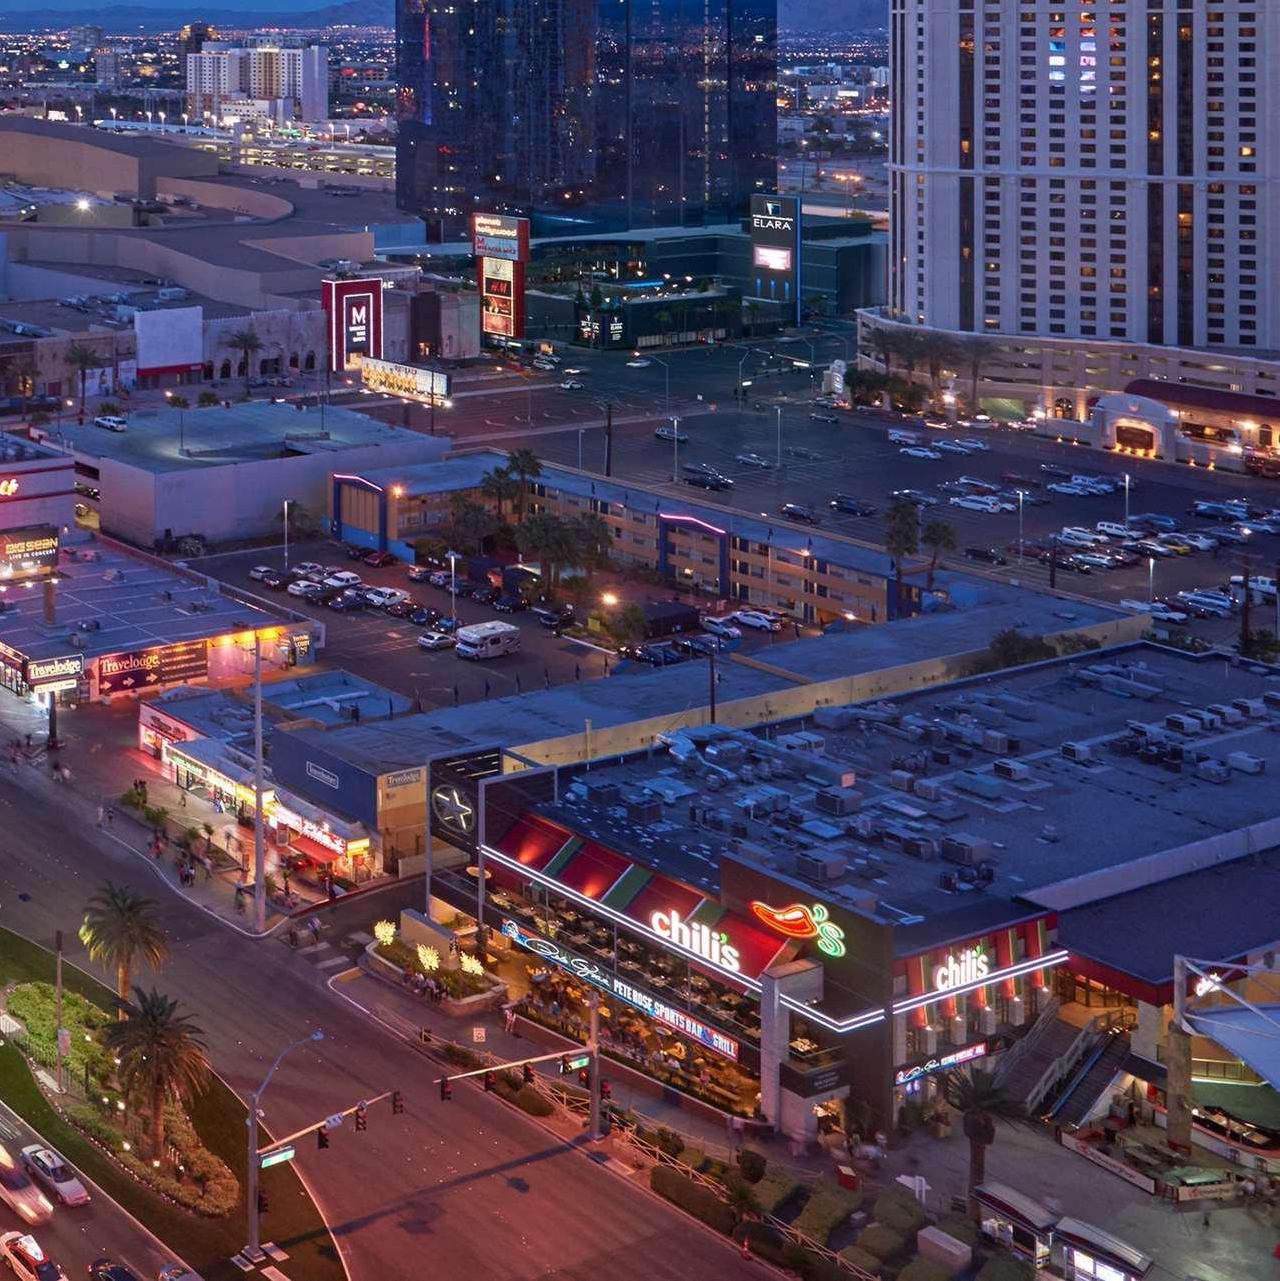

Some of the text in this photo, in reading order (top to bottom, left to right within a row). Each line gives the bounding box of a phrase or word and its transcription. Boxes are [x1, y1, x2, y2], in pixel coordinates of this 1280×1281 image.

[753, 218, 792, 230] ELARA
[352, 305, 366, 325] M
[28, 660, 81, 677] Travelodge
[650, 910, 741, 971] chili's
[936, 945, 990, 992] chili's
[613, 978, 633, 1000] PETE
[632, 988, 653, 1011] ROSE
[653, 1000, 686, 1031] SPORTS
[685, 1016, 703, 1039] BAR
[712, 1033, 738, 1058] GRILL
